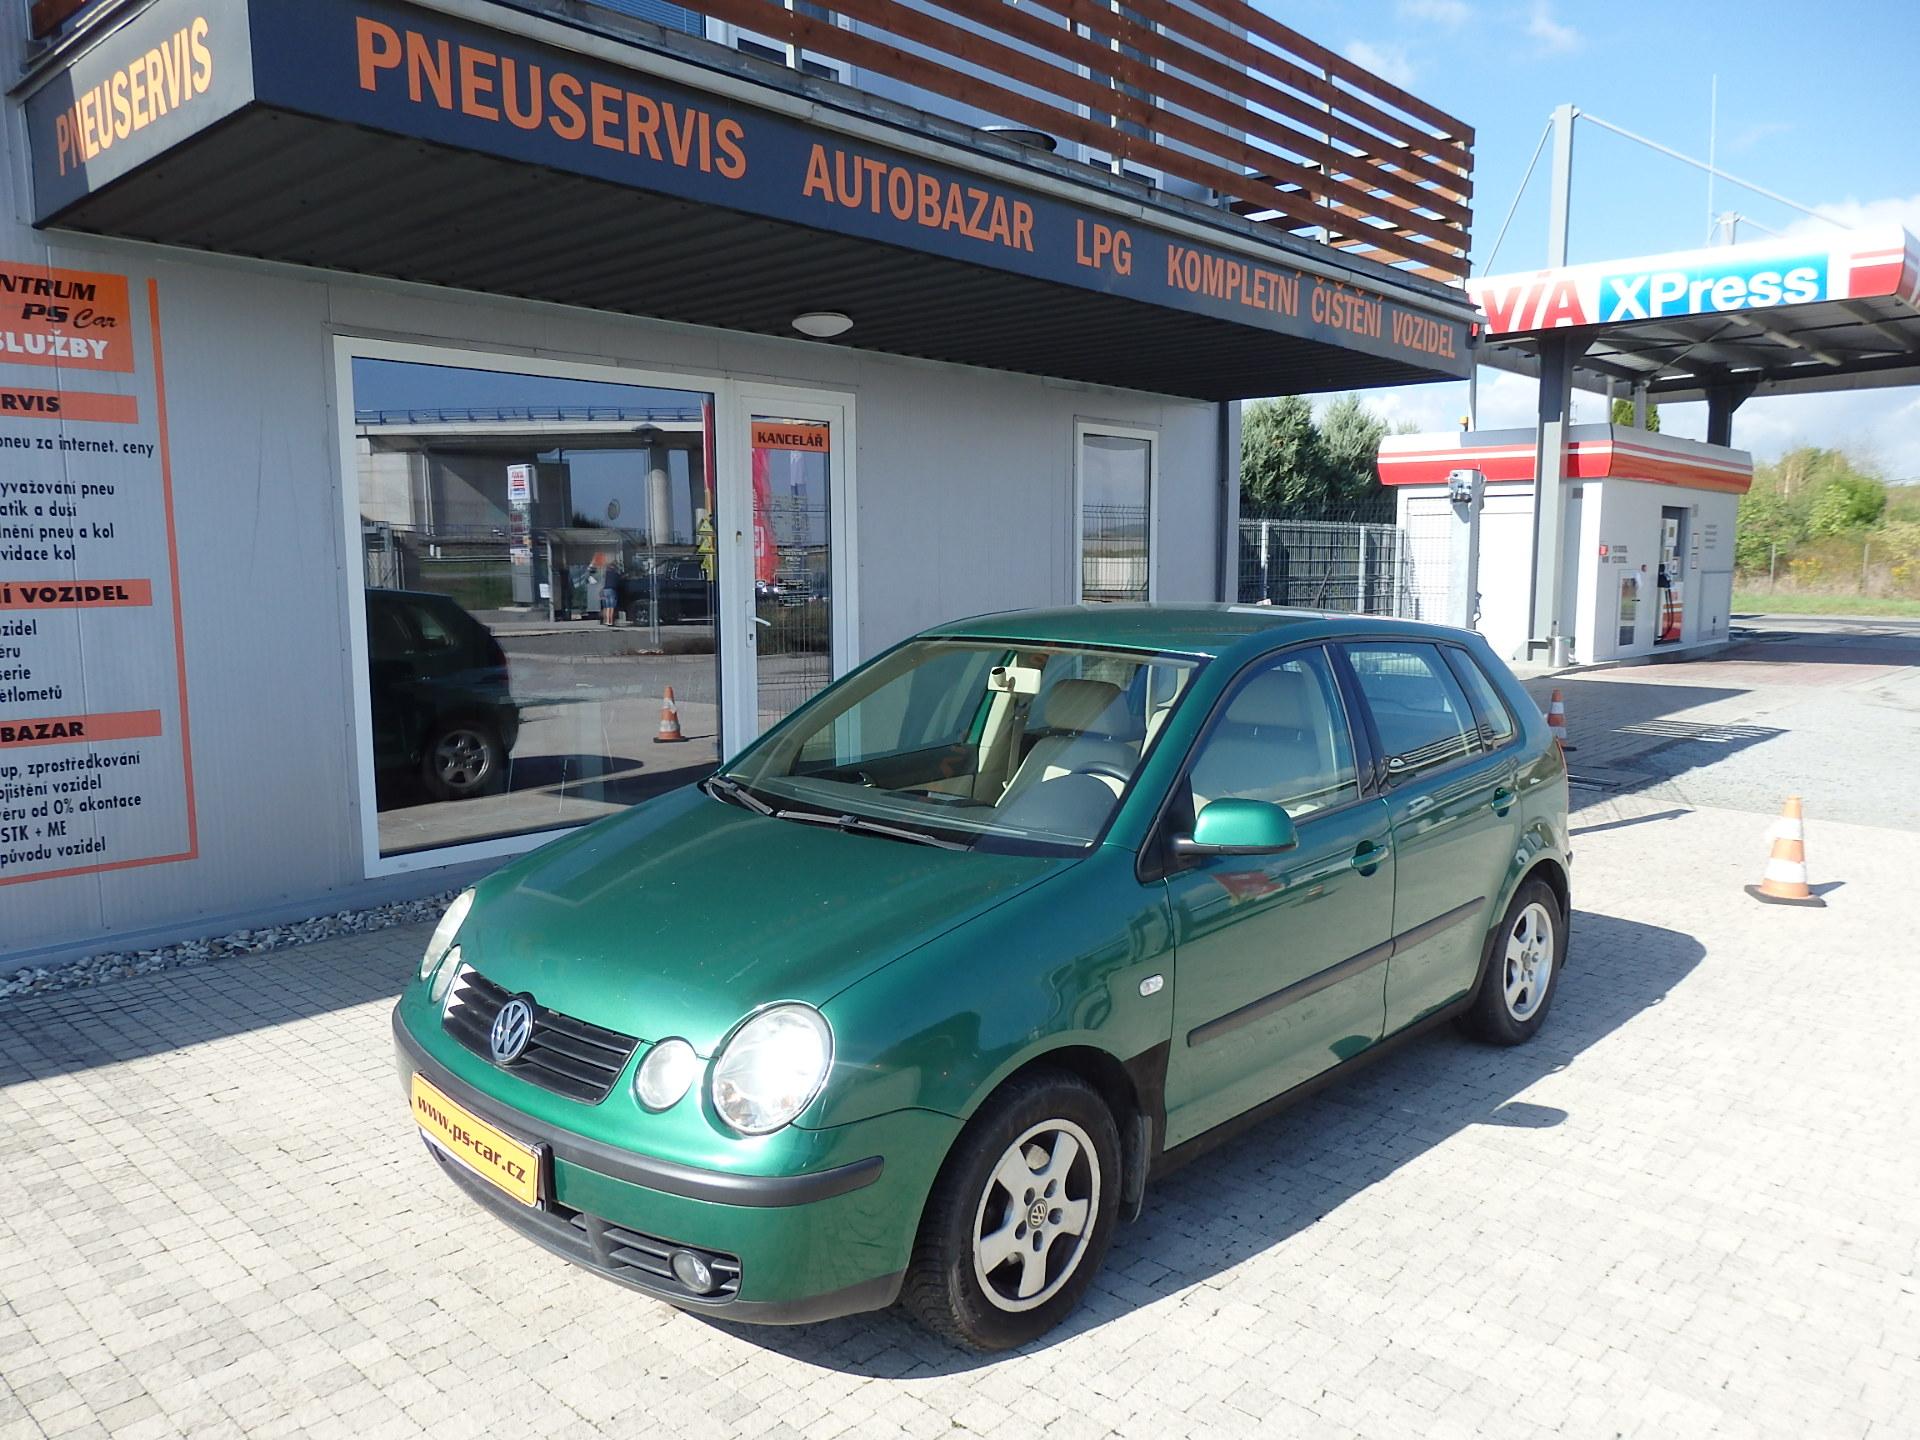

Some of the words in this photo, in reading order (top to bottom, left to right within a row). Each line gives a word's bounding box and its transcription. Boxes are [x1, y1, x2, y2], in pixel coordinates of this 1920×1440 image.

[56, 16, 213, 177] PNEUSERVIS
[355, 16, 748, 181] PNEUSERVIS
[802, 143, 1034, 253] AUTOBAZAR
[1075, 218, 1133, 277] LPG
[1167, 244, 1300, 318] KOMPLETNÍ
[1311, 276, 1383, 340] ČIŠTĚNÍ
[1392, 309, 1456, 359] VOZIDEL
[1607, 265, 1819, 322] XPress
[21, 302, 70, 324] PS
[73, 308, 118, 329] Car
[36, 438, 53, 450] za
[122, 443, 154, 459] ceny
[757, 431, 824, 448] KANCELÁŘ
[81, 484, 115, 499] pneu
[34, 505, 43, 516] a
[39, 527, 74, 543] pneu
[79, 528, 87, 539] a
[92, 521, 114, 539] kol
[53, 543, 76, 561] kol
[19, 585, 129, 604] VOZIDEL
[0, 721, 85, 743] BAZAR
[52, 774, 102, 793] vozidel
[31, 801, 48, 818] od
[53, 798, 74, 815] 0%
[79, 795, 142, 813] akontace
[1, 825, 29, 843] STK
[47, 820, 67, 838] ME
[57, 836, 106, 857] vozidel
[416, 1095, 527, 1185] www.ps-car.cz
